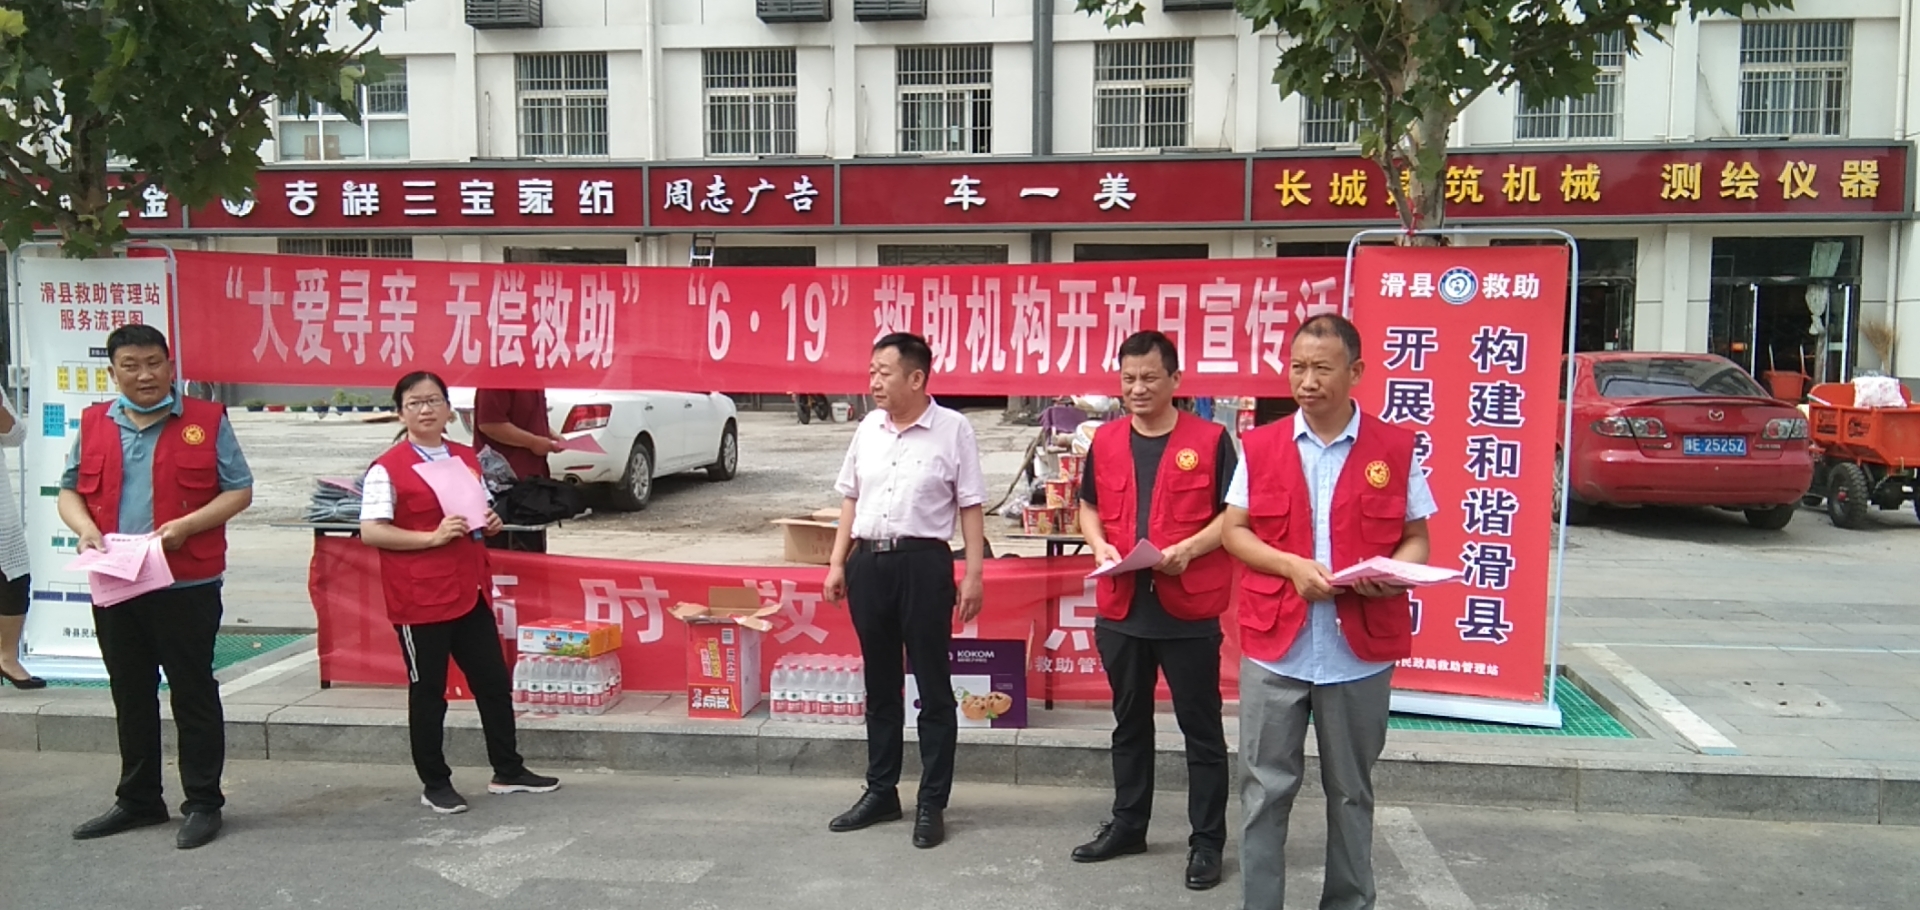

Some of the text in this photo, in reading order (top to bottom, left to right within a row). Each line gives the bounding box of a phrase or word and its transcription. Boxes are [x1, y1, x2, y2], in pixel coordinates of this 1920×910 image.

[663, 174, 820, 214] 周志广告
[944, 171, 1137, 211] 车一美
[1661, 159, 1881, 199] 测绘仪器
[284, 178, 615, 217] 吉祥三宝家纺
[40, 282, 160, 305] 滑县救助管理站
[1380, 272, 1435, 299] 滑县
[1482, 273, 1540, 299] 救助
[60, 308, 144, 332] 服务流程图
[1455, 325, 1529, 644] 构建和谐滑县
[957, 650, 995, 658] KOKOM
[1395, 657, 1499, 676] 民政局救助管理站
